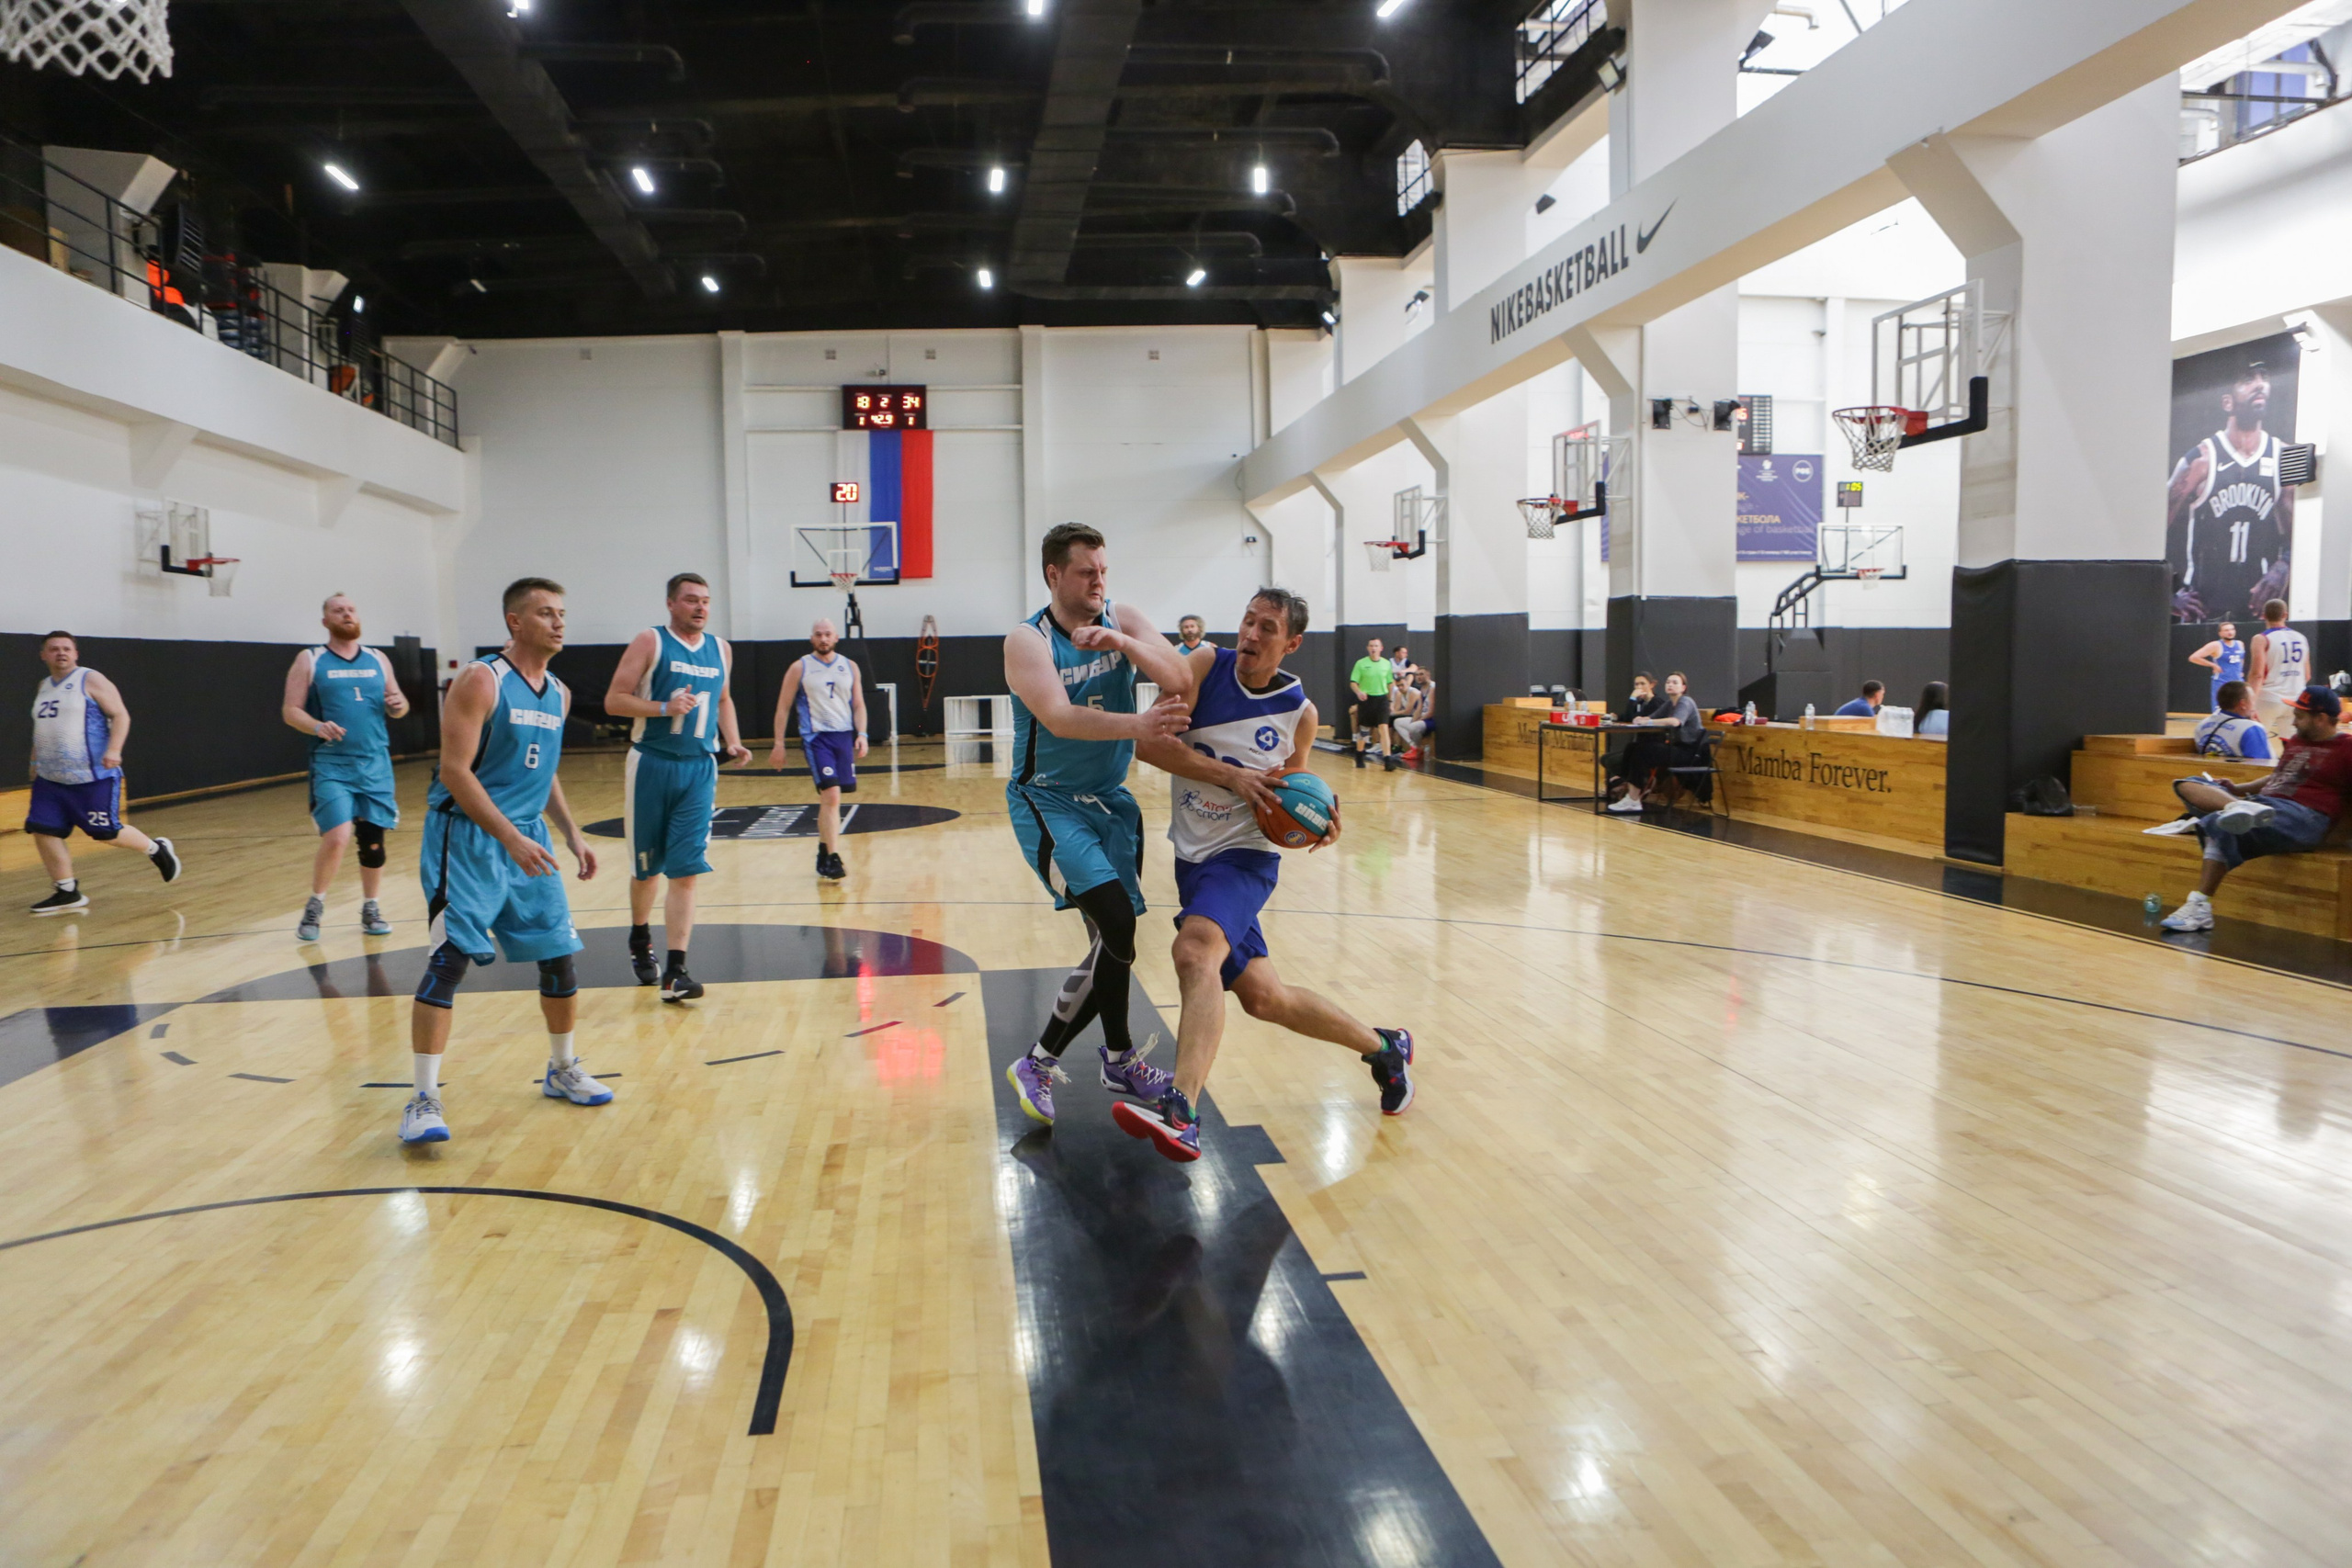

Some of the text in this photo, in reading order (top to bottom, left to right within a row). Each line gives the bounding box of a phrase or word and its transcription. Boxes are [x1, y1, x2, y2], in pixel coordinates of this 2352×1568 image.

[1491, 223, 1629, 344] NIKEBASKETBALL
[879, 397, 889, 408] 2
[902, 396, 921, 409] 34
[836, 483, 857, 502] 20
[2209, 482, 2274, 520] BROOKLYN
[2229, 521, 2250, 562] 11
[2281, 642, 2302, 664] 15
[1059, 650, 1123, 686] СИБУР
[353, 686, 364, 702] 1
[826, 682, 835, 698] 7
[38, 700, 60, 718] 25
[670, 687, 711, 739] 11
[525, 743, 540, 769] 6
[1736, 745, 1892, 793] Mamba Forever.
[87, 811, 110, 827] 25
[1196, 808, 1232, 821] СПОРТ
